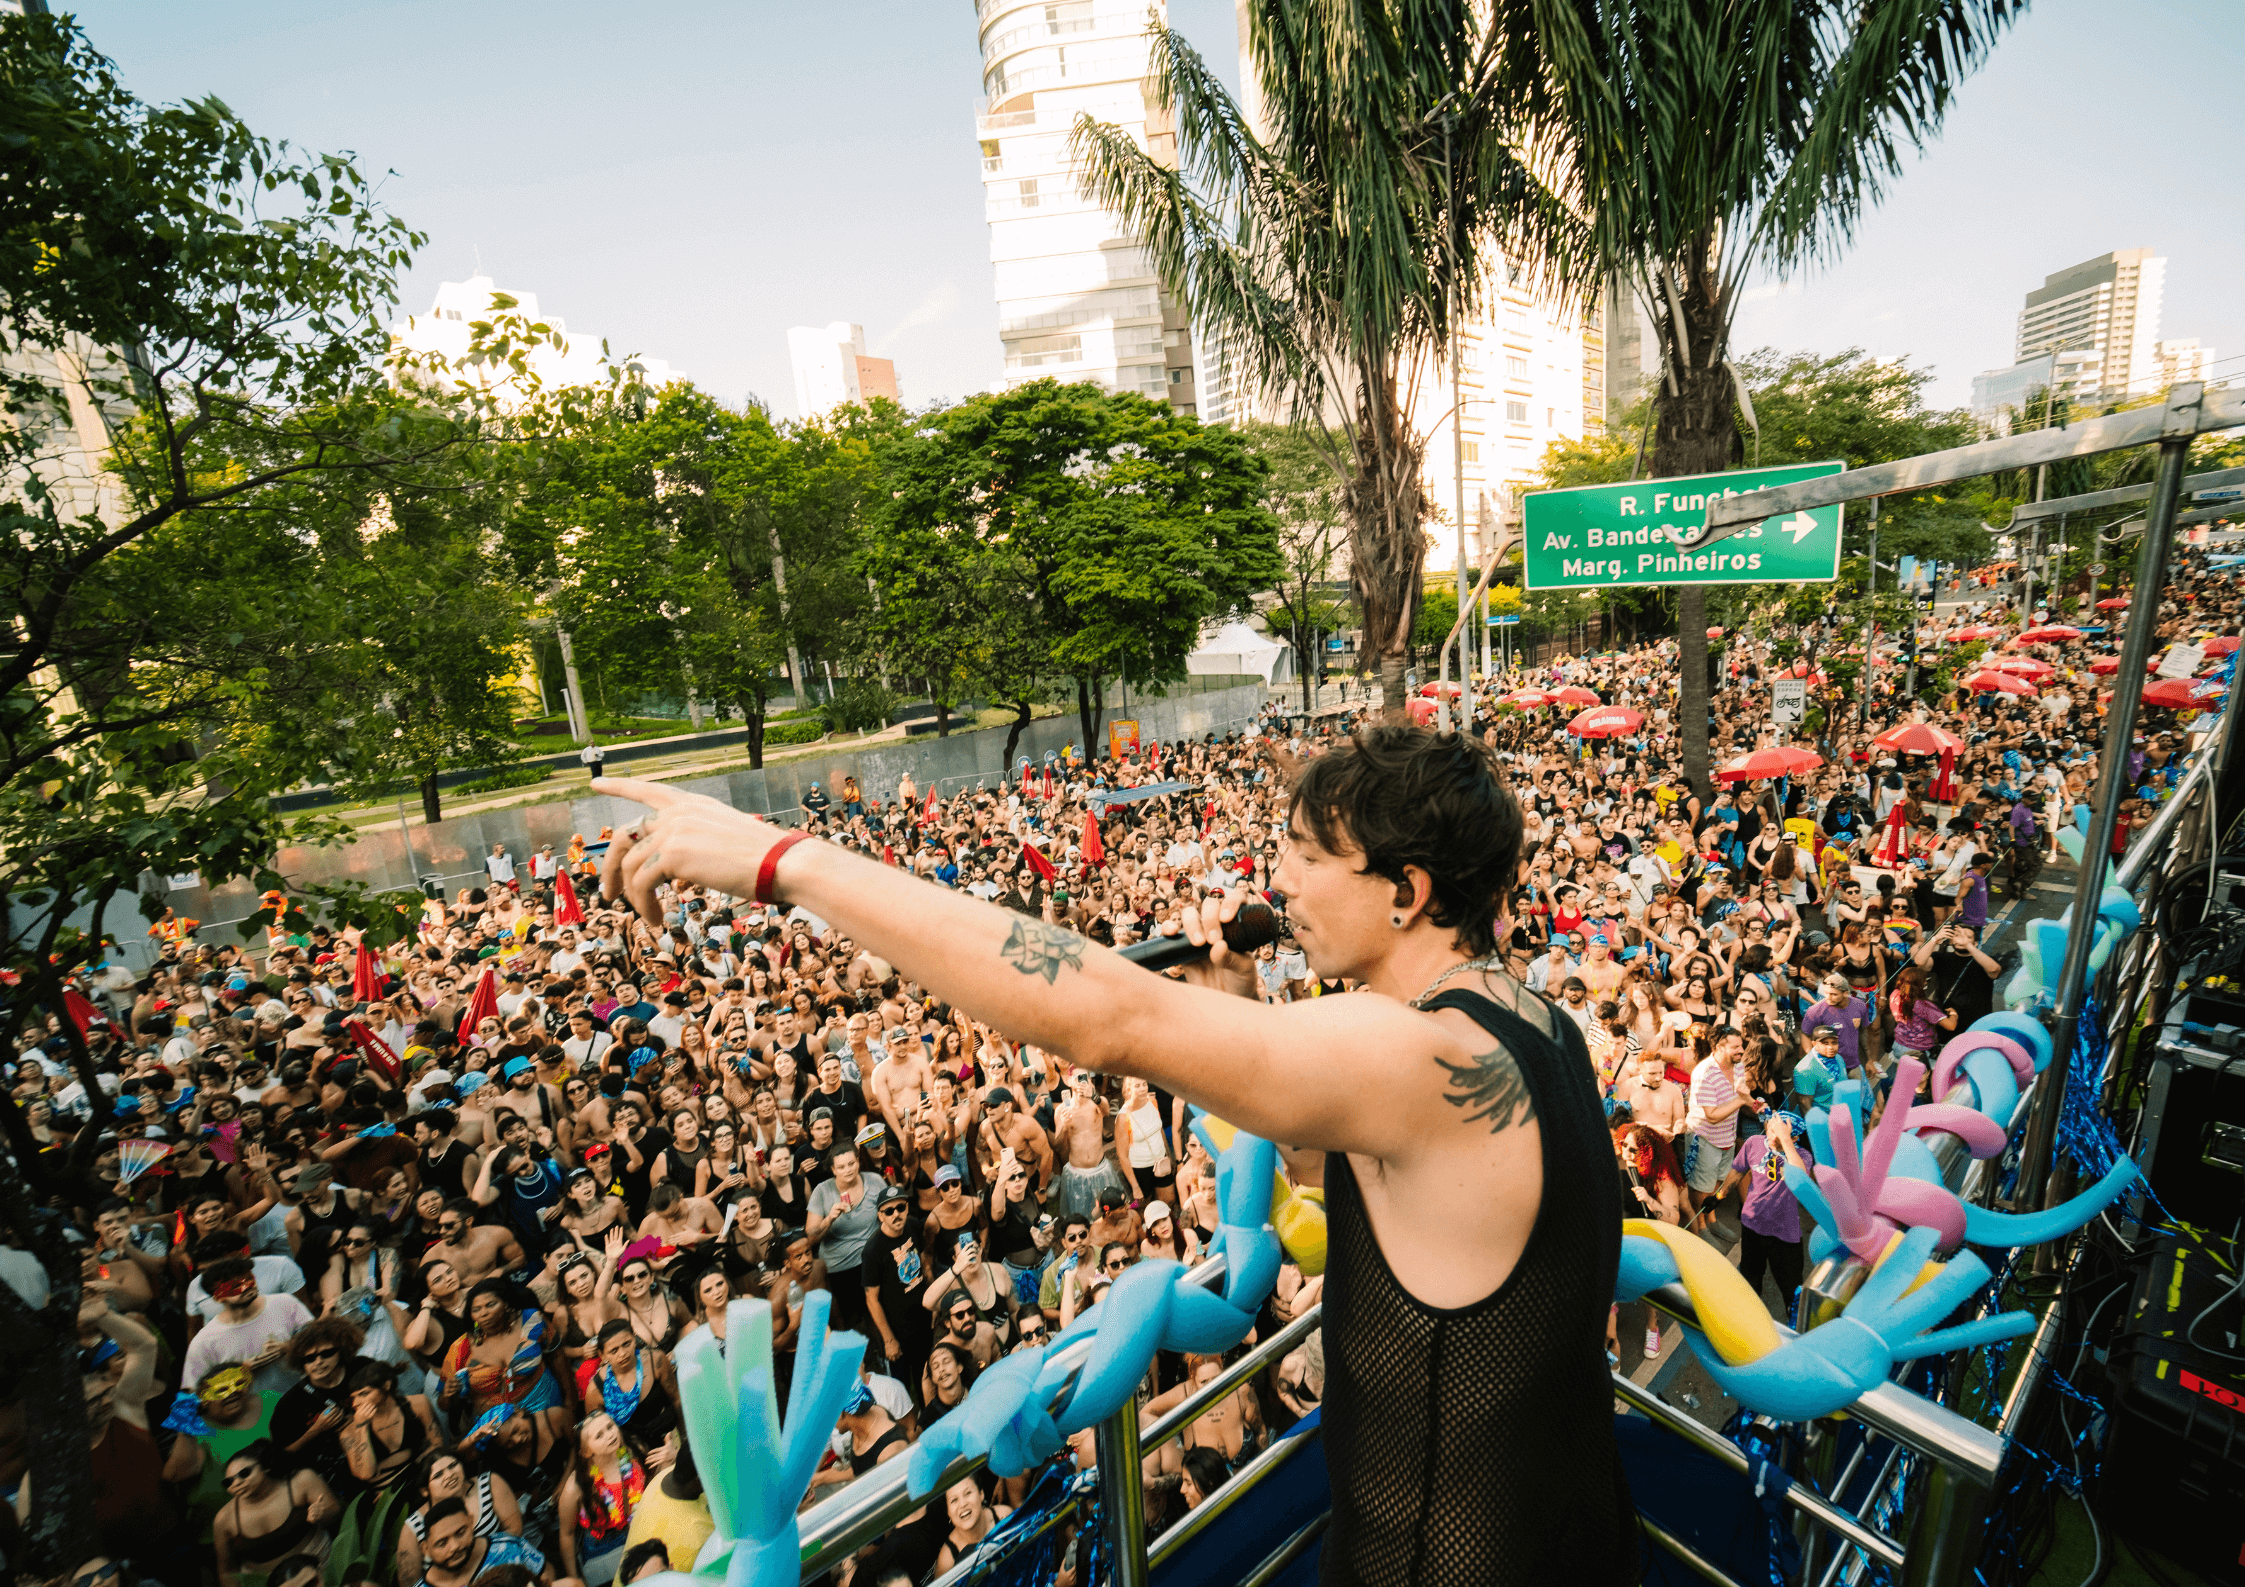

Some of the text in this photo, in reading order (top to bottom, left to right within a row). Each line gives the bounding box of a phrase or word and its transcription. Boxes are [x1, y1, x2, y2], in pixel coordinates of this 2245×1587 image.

[1619, 495, 1645, 516] R.
[1543, 531, 1578, 551] Av.
[1562, 551, 1762, 580] Marg. Pinheiros
[1589, 716, 1627, 728] BRAHMA
